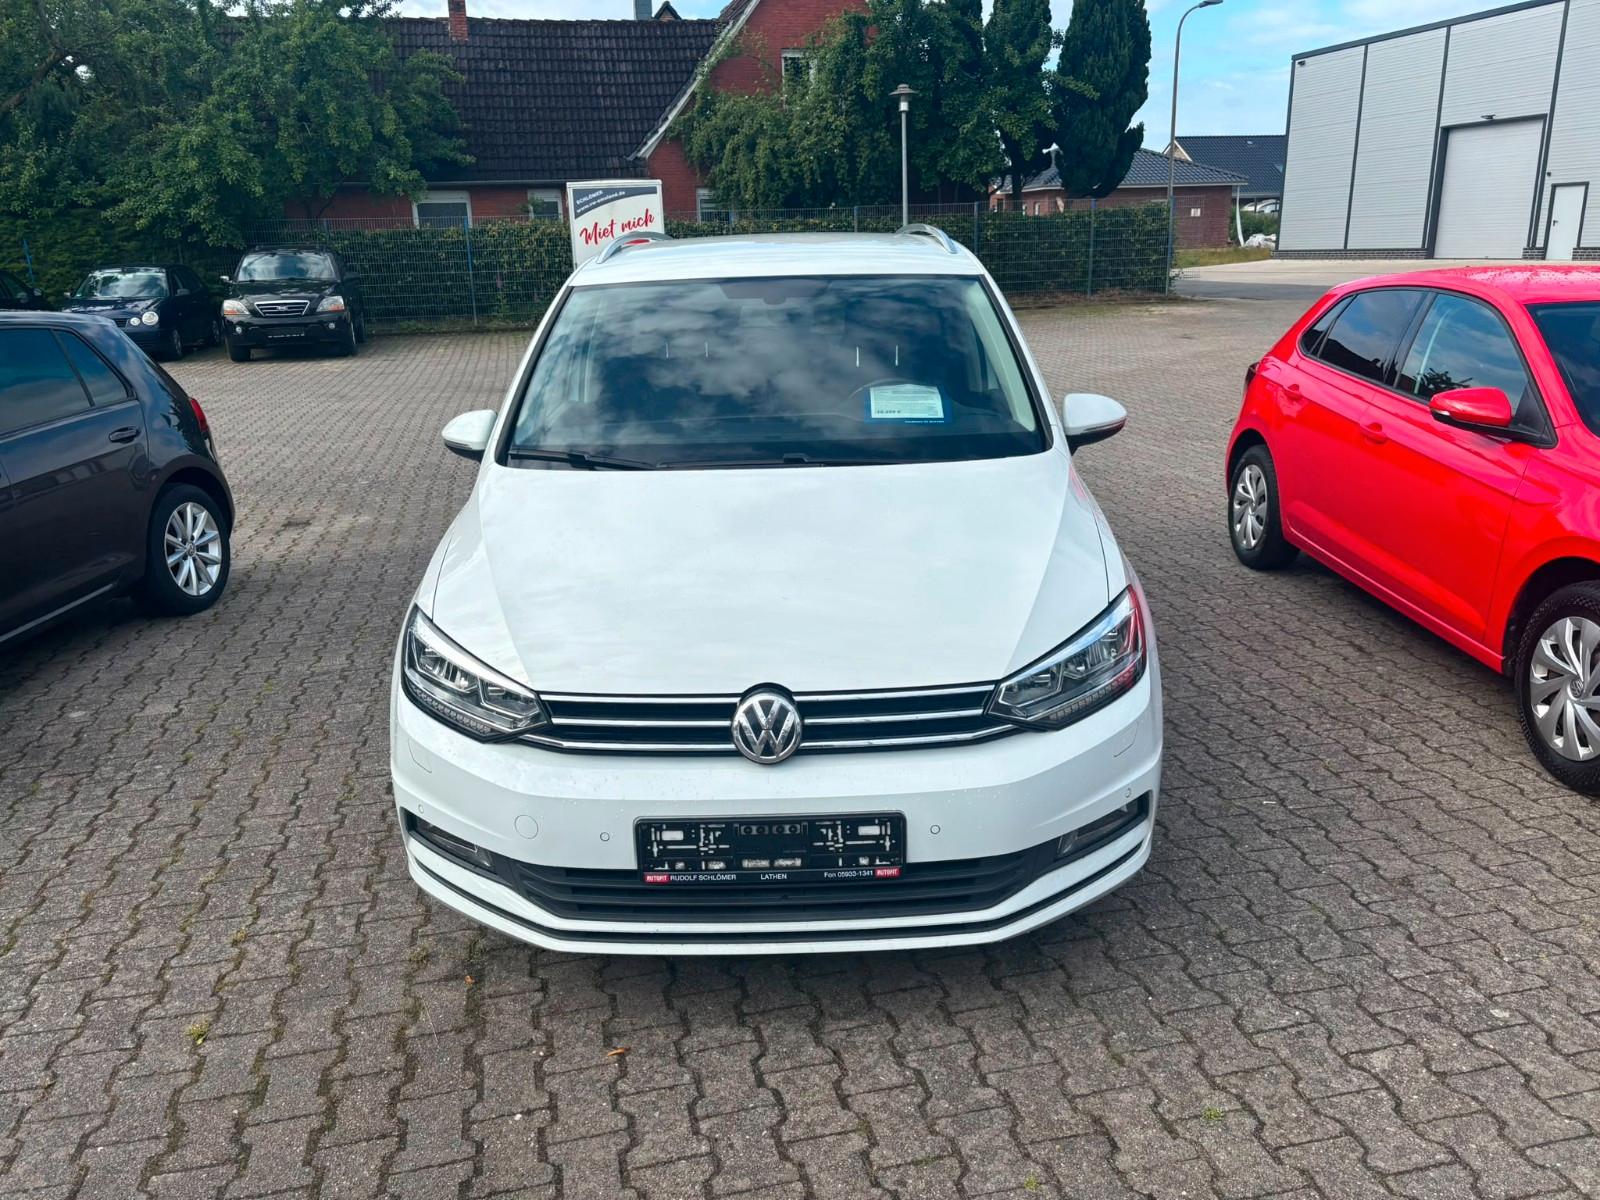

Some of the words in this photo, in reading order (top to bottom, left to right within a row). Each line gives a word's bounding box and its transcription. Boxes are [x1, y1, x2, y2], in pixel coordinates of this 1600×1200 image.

[579, 218, 616, 245] Miet
[621, 208, 655, 233] mich
[698, 873, 737, 881] SCHLÖMER
